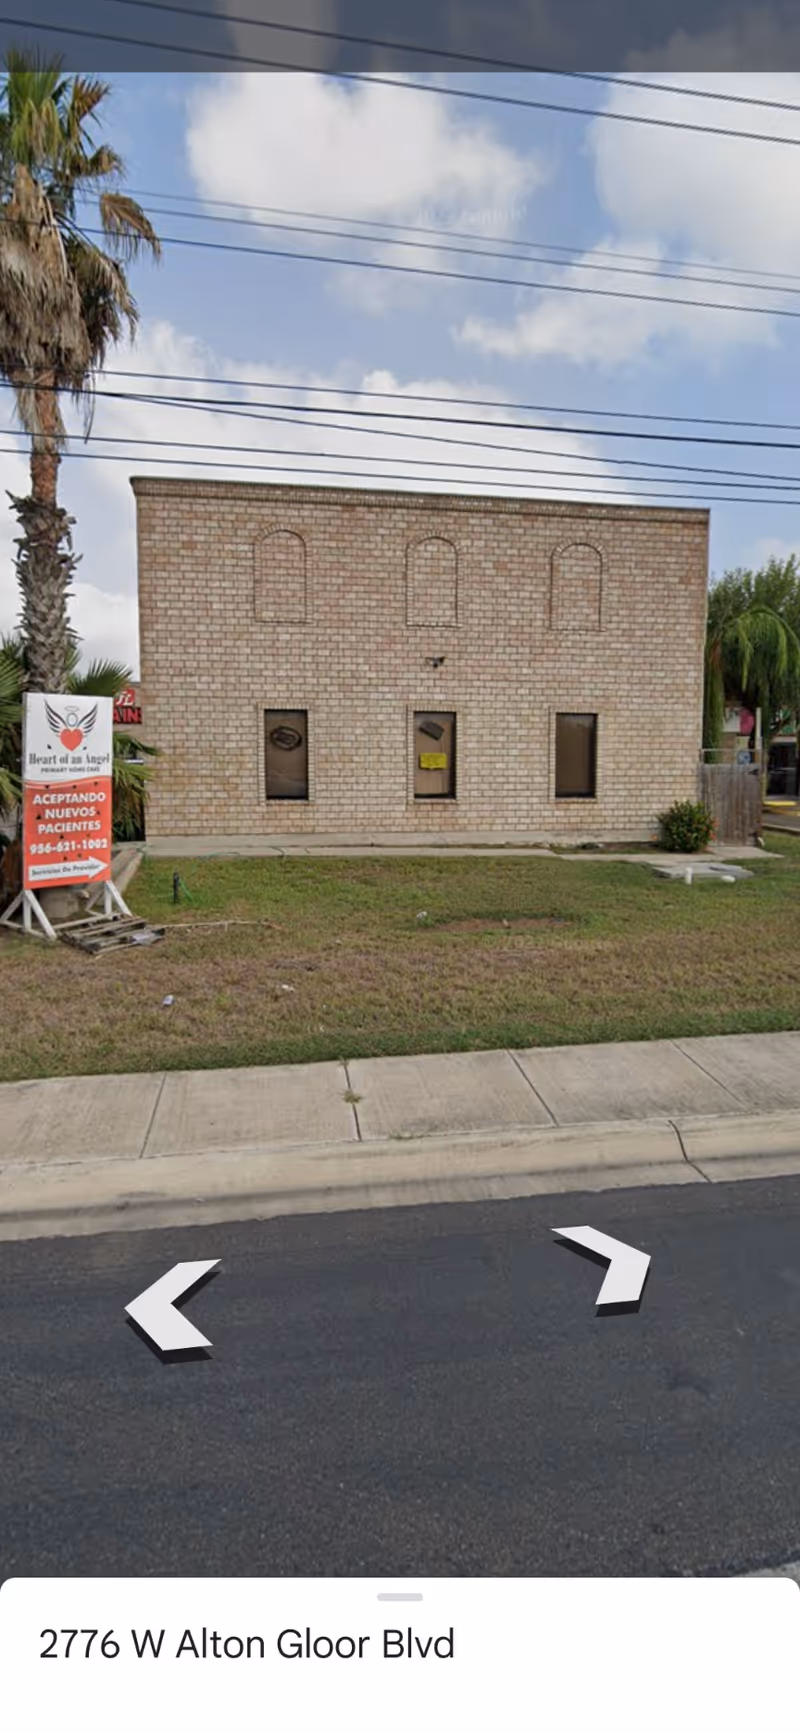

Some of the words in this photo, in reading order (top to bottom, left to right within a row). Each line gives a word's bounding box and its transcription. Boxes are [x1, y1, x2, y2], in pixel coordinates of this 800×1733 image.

[29, 753, 57, 765] Heart
[59, 754, 69, 765] of
[71, 755, 82, 765] an
[86, 753, 110, 765] Angel
[32, 792, 106, 805] ACEPTANDO
[44, 806, 96, 819] NUEVOS
[38, 820, 101, 834] PACIENTES
[29, 838, 108, 855] 956-621-1002
